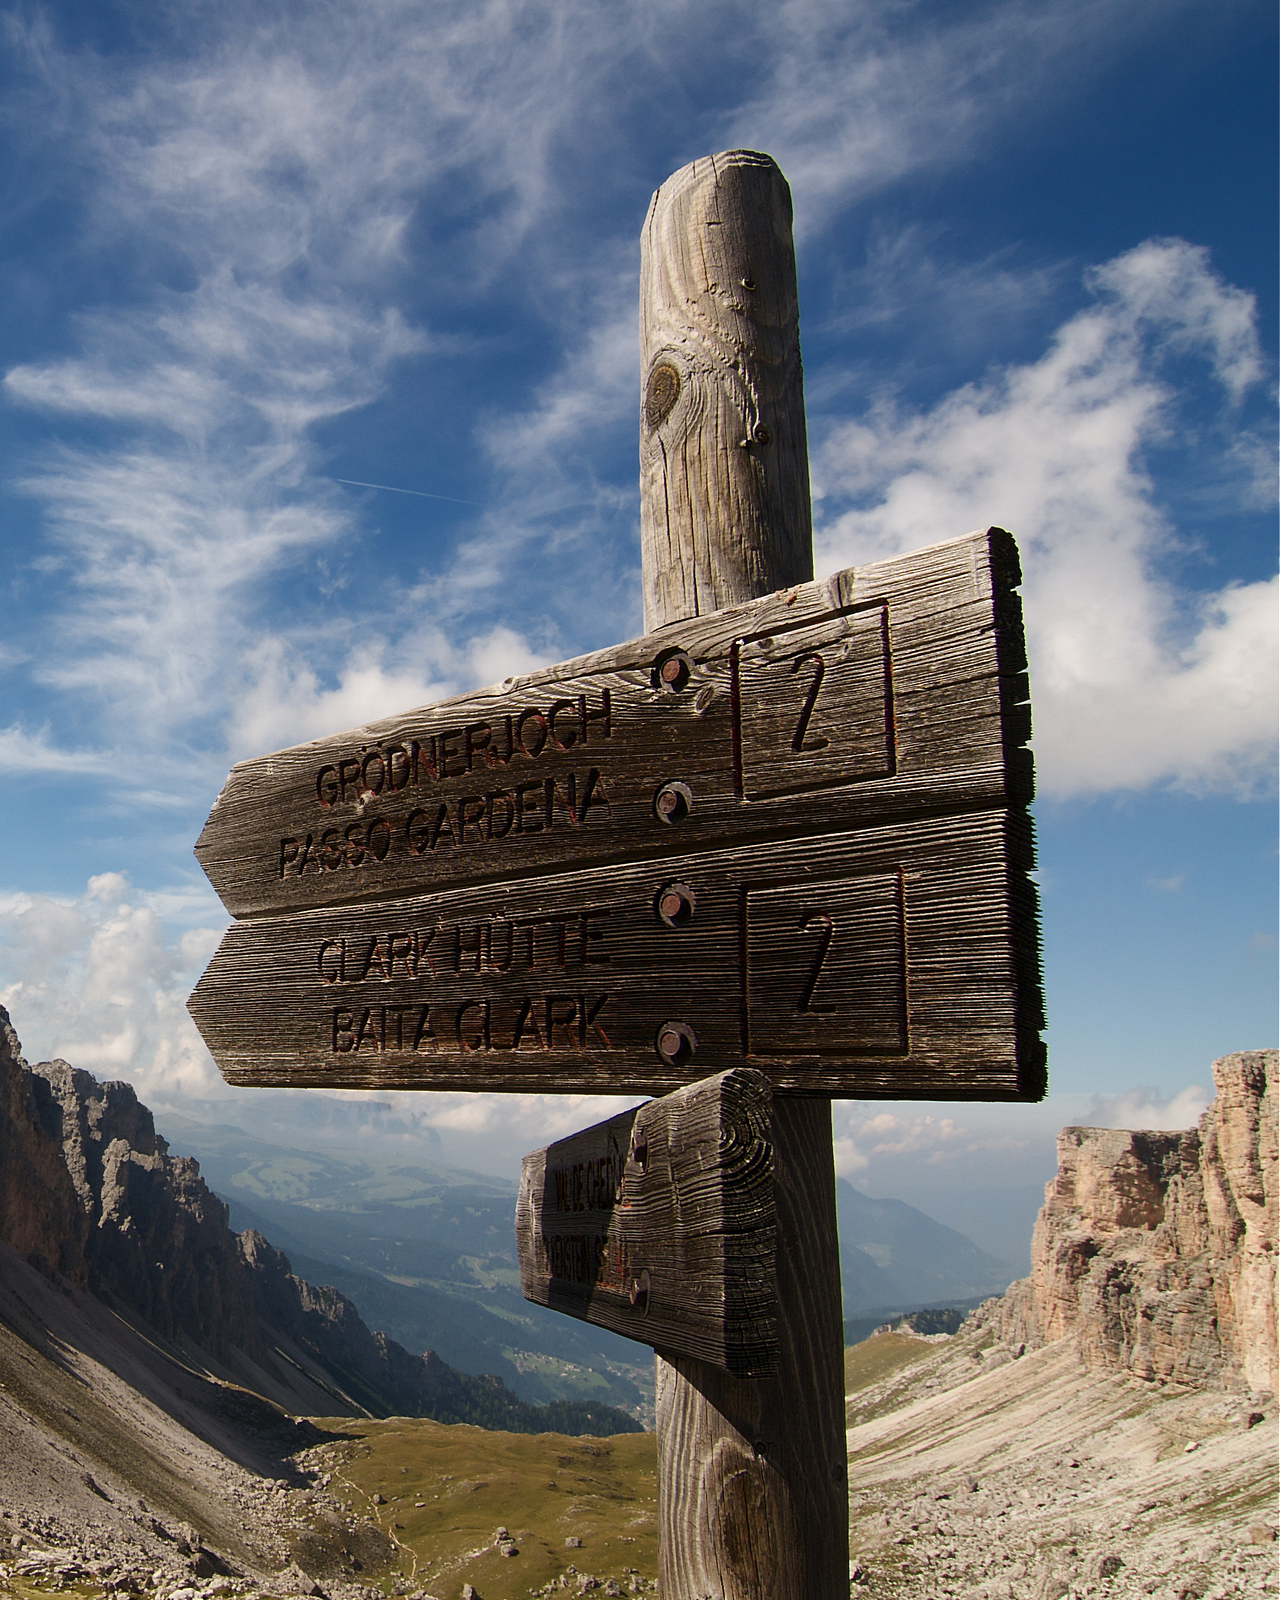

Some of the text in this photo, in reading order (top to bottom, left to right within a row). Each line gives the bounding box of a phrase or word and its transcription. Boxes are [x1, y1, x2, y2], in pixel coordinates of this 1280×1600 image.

[316, 687, 612, 809] GRÖDNERJOCH
[792, 651, 829, 752] 2
[279, 767, 613, 880] PASSO GARDENA
[318, 909, 612, 985] CLARK HÜTTE
[797, 909, 836, 1014] 2
[332, 991, 613, 1053] BAITA CLARK
